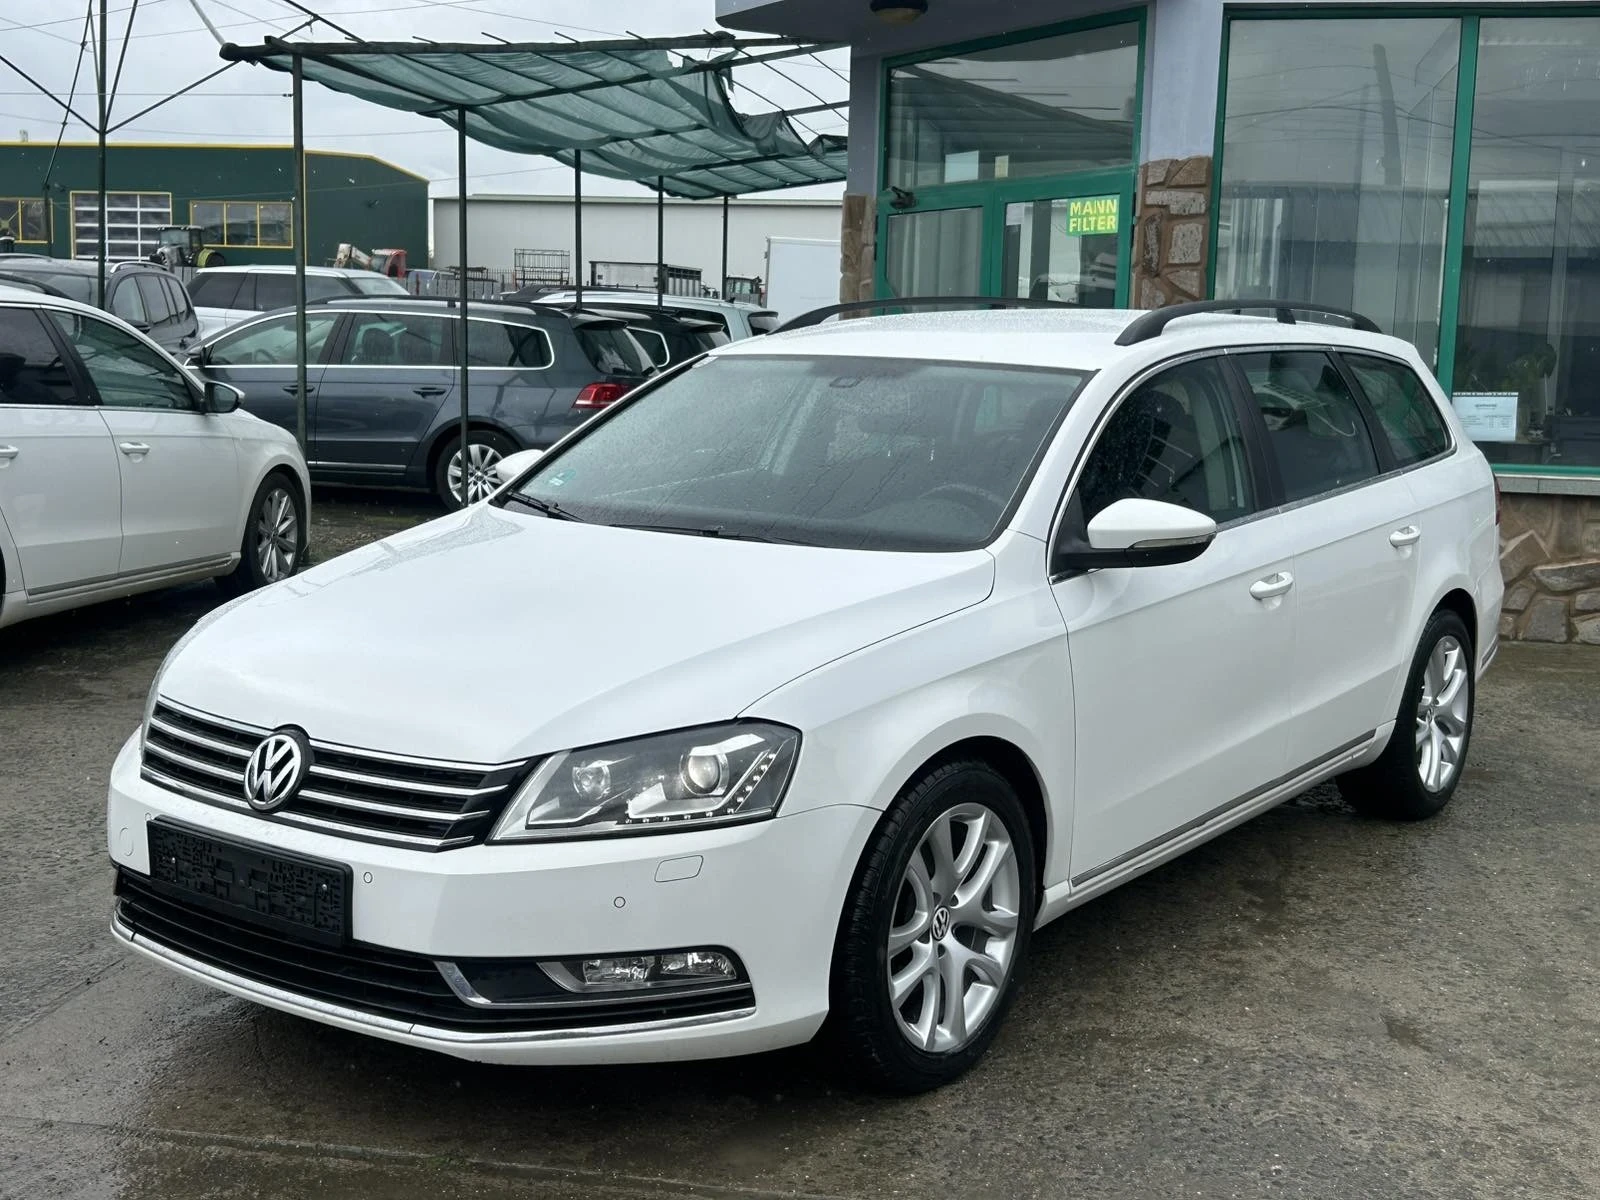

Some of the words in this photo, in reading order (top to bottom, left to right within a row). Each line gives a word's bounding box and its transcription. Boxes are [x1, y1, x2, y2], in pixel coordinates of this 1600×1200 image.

[1070, 199, 1116, 216] MANN
[1069, 215, 1115, 232] FILTER
[245, 734, 301, 806] VW
[932, 907, 950, 940] VW
